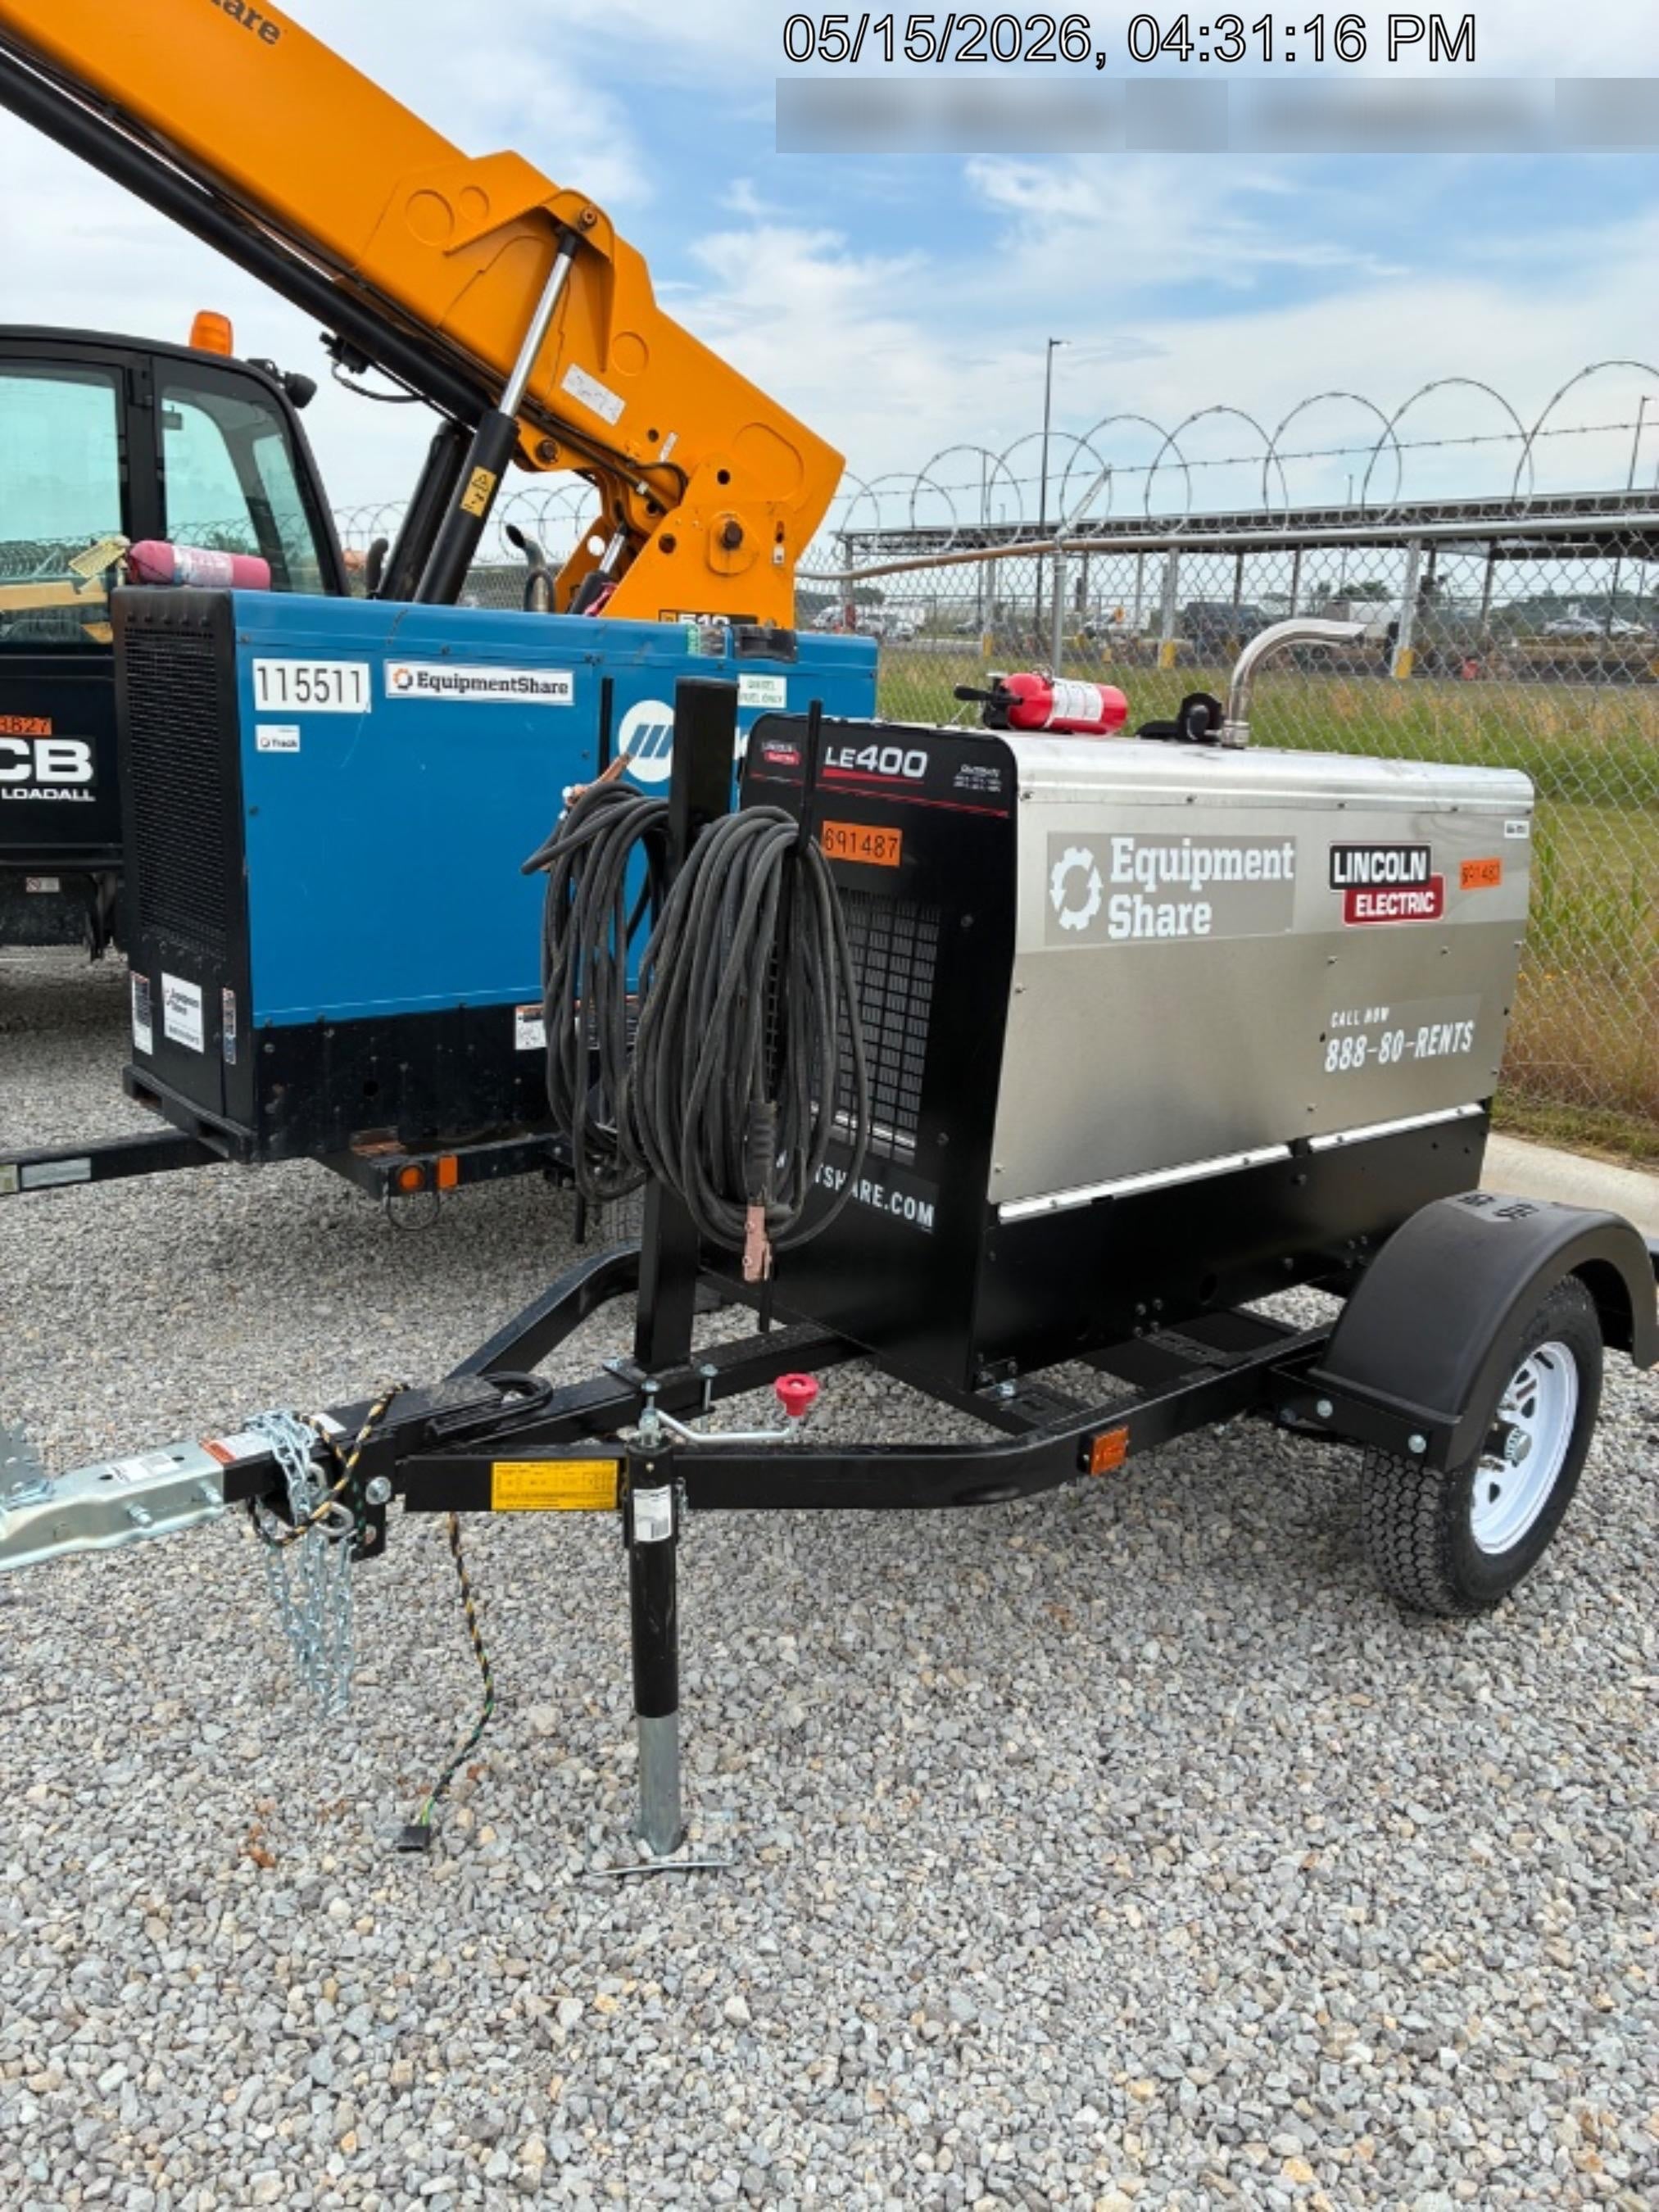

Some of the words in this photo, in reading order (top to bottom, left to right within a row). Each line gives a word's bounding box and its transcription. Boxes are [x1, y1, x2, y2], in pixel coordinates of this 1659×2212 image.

[211, 0, 280, 44] are
[257, 665, 360, 704] 115511
[416, 670, 569, 695] EquipmentShare
[825, 745, 927, 777] LE400
[2, 787, 97, 802] LOADALL
[824, 827, 899, 859] 691487
[1110, 837, 1294, 892] Equipment
[1334, 851, 1427, 883] LINCOLN
[1108, 894, 1213, 939] Share
[1354, 891, 1435, 918] ELECTRIC
[1330, 1009, 1360, 1028] CALL
[1324, 1020, 1475, 1072] 888-80-RENTS
